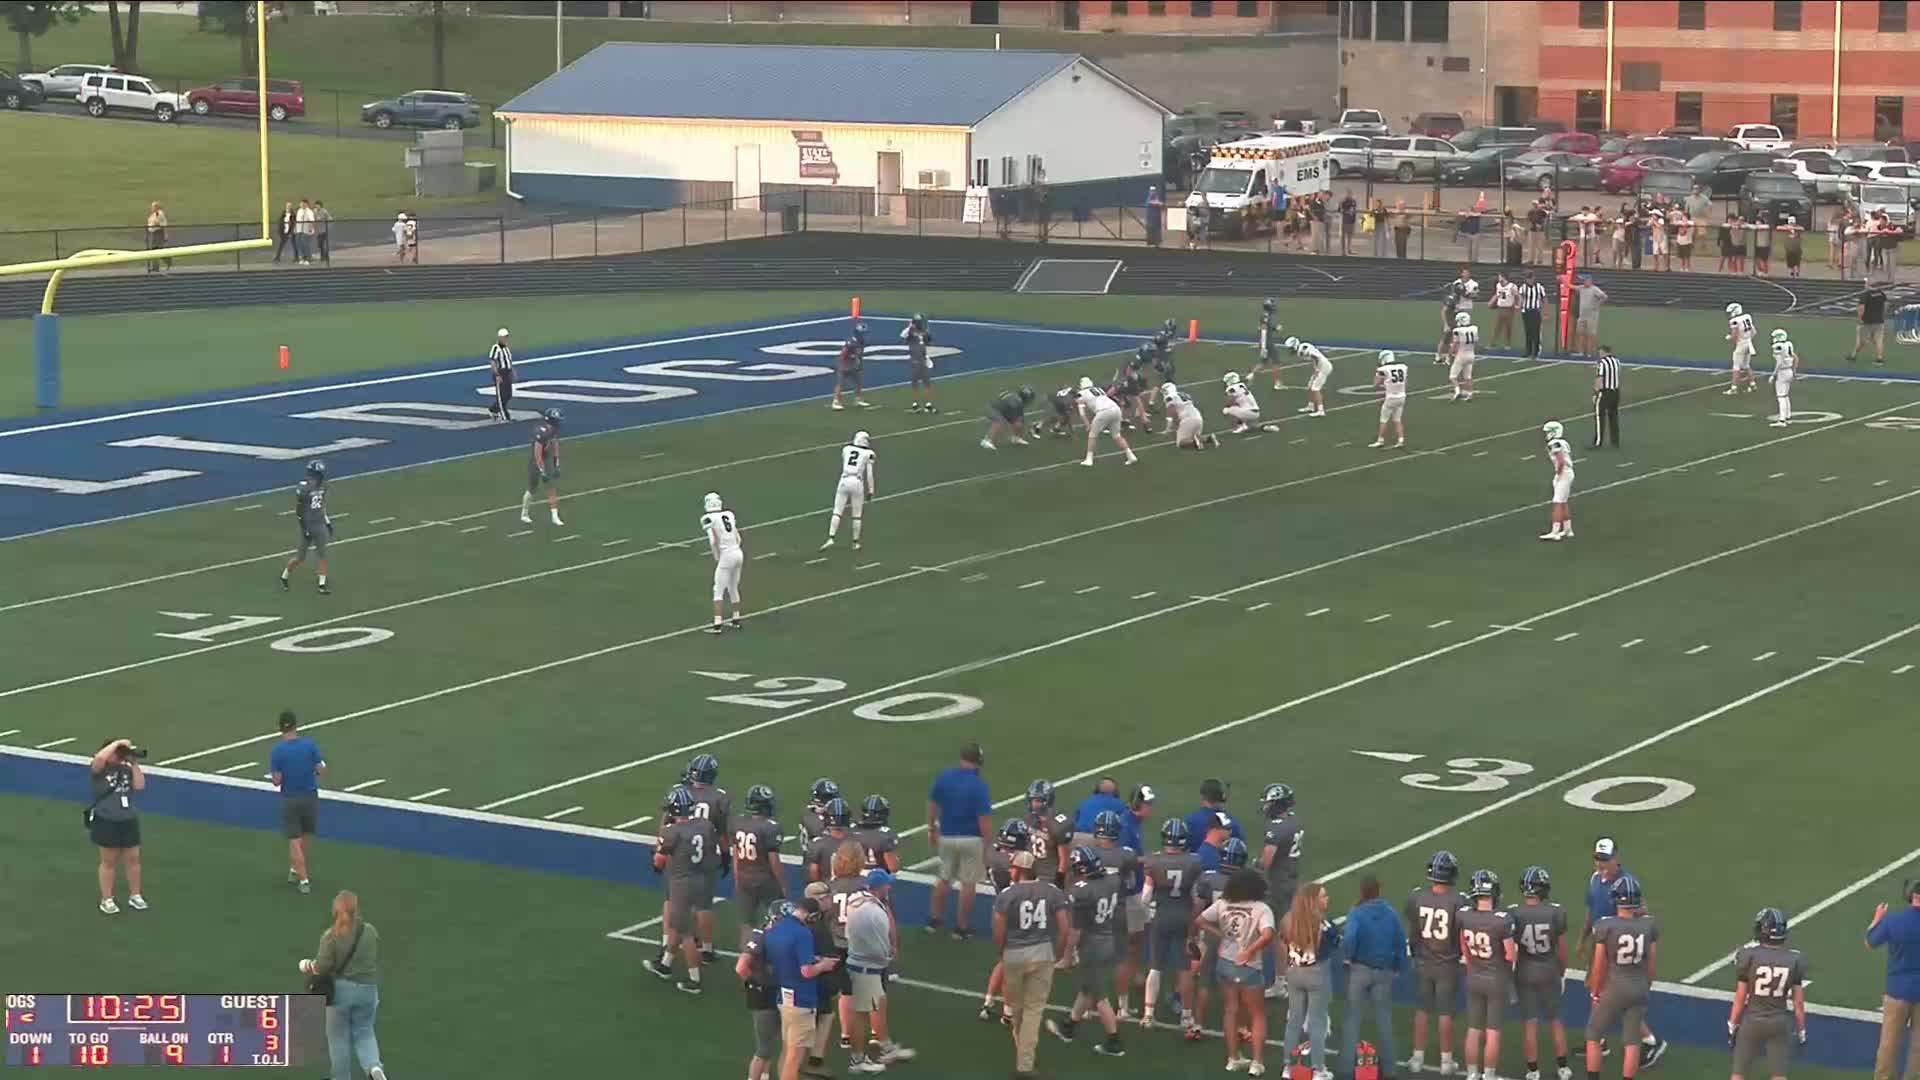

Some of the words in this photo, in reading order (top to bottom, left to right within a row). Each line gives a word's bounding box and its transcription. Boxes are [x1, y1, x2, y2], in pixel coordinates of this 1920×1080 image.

[1297, 167, 1320, 182] EMS
[1465, 331, 1475, 345] 11
[1391, 369, 1405, 384] 58
[848, 451, 860, 467] 2
[721, 514, 733, 533] 6
[691, 834, 704, 865] 3
[736, 830, 758, 861] 36
[1167, 869, 1183, 897] 7
[1019, 899, 1047, 930] 64
[1419, 906, 1449, 940] 73
[1519, 923, 1552, 954] 45
[1616, 934, 1645, 965] 21
[1755, 966, 1790, 998] 27
